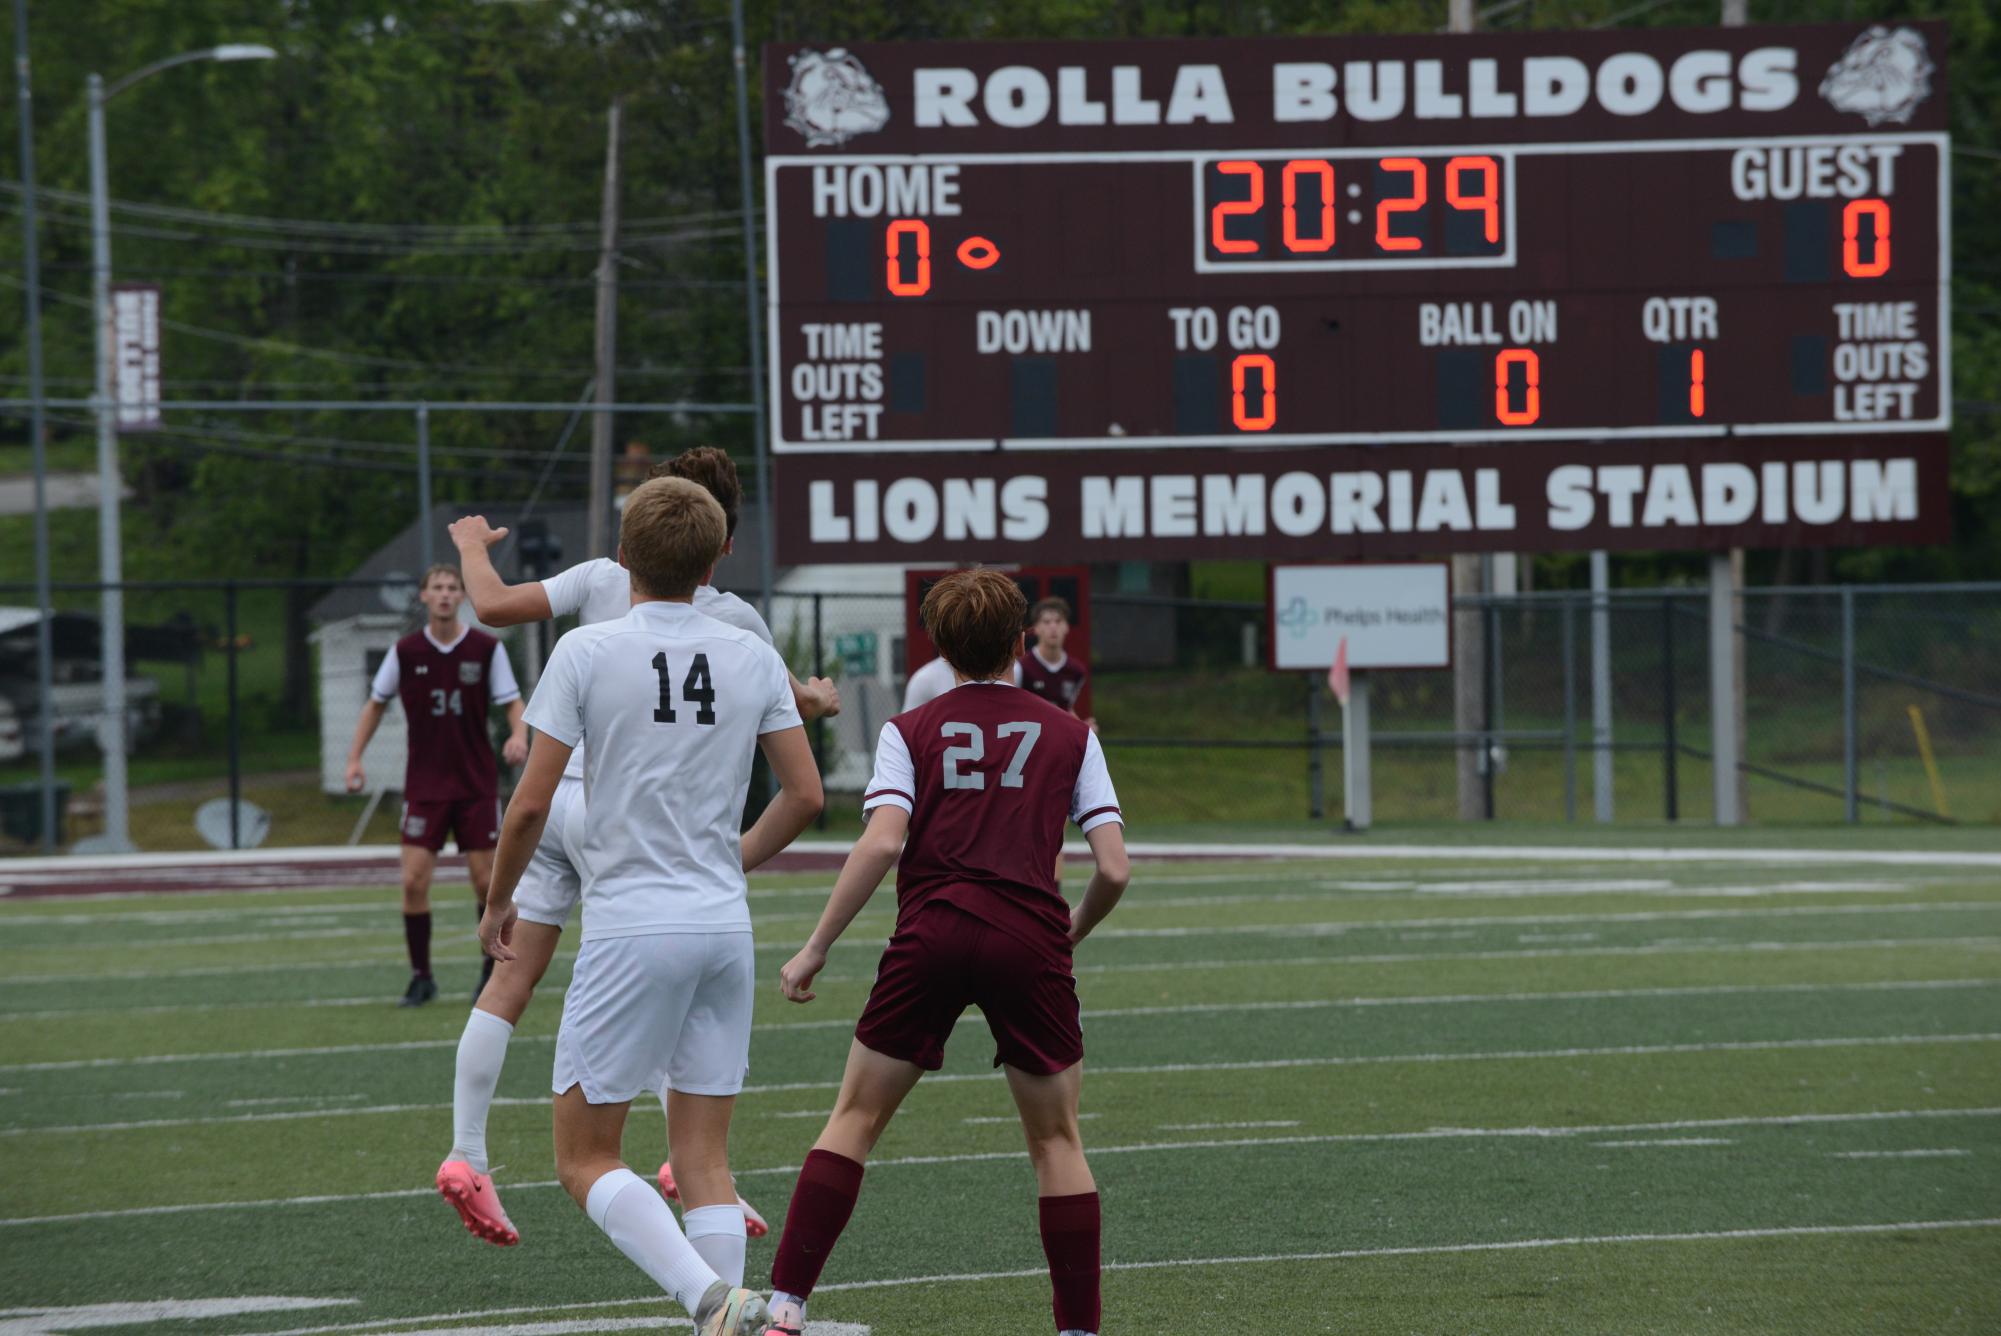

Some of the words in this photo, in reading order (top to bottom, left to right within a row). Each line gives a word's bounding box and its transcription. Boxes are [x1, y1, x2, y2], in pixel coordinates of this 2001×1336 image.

[914, 65, 1234, 128] ROLLA
[1273, 47, 1799, 122] BULLDOGS
[813, 165, 962, 217] HOME
[1730, 146, 1903, 200] GUEST
[1212, 156, 1499, 254] 20:29
[886, 220, 931, 297] 0
[1842, 199, 1891, 278] 0
[801, 323, 883, 360] TIME
[976, 309, 1092, 354] DOWN
[1168, 307, 1218, 351] TO
[1227, 305, 1281, 350] GO
[1419, 303, 1502, 346] BALL
[1509, 300, 1557, 345] ON
[1642, 296, 1719, 343] QTR
[1833, 302, 1917, 340] TIME
[791, 362, 884, 401] OUTS
[1690, 349, 1705, 417] 1
[1833, 342, 1928, 381] OUTS
[1231, 354, 1276, 431] 0
[1495, 349, 1540, 426] 0
[1834, 384, 1918, 420] LEFT
[801, 404, 883, 440] LEFT
[809, 475, 1050, 542] LIONS
[1081, 466, 1516, 539] MEMORIAL
[1546, 458, 1918, 530] STADIUM
[1323, 606, 1381, 626] Phelps
[1386, 606, 1445, 625] Health
[430, 688, 463, 716] 34
[651, 651, 716, 725] 14
[940, 721, 1042, 790] 27
